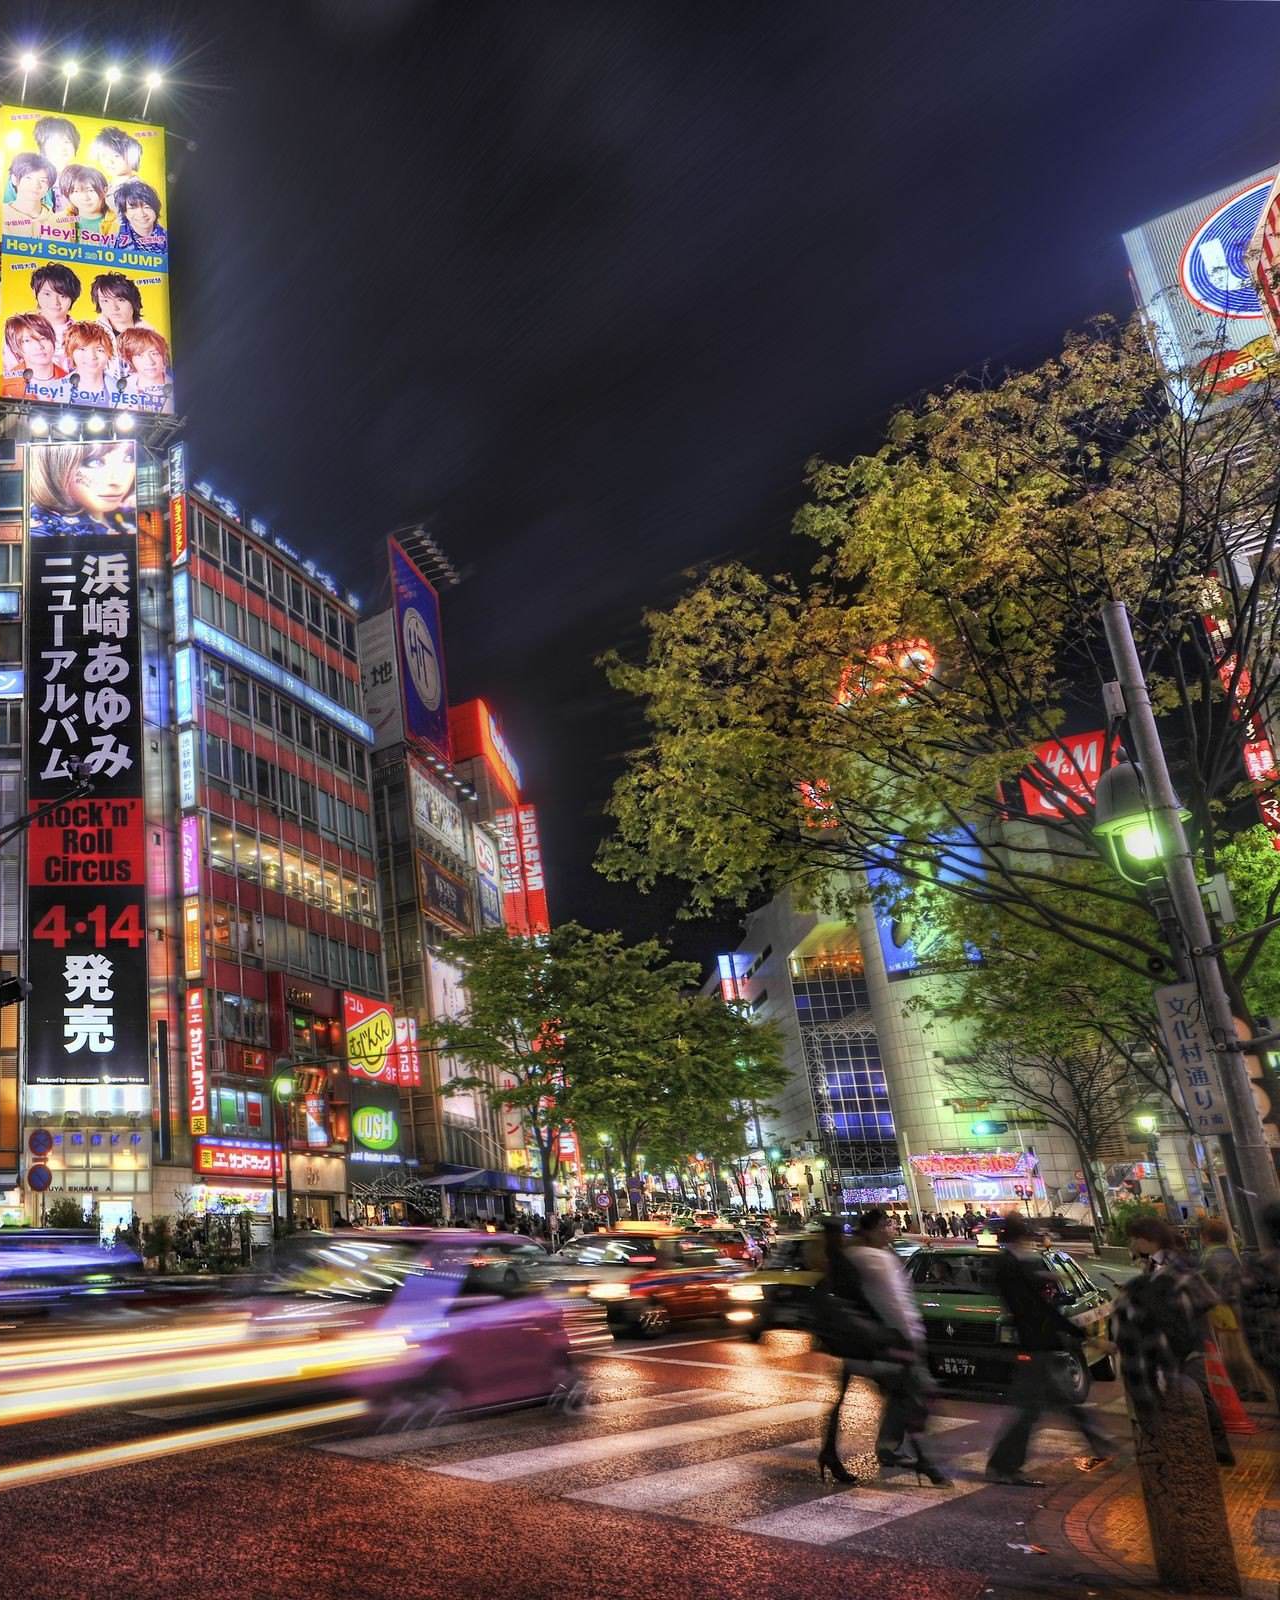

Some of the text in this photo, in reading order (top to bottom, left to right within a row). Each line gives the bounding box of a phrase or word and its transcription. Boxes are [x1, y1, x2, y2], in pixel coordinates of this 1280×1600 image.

[40, 225, 77, 241] Hey!
[81, 230, 115, 246] Say!
[6, 240, 43, 254] Hey!
[48, 244, 82, 259] Say!
[118, 254, 163, 267] JUMP
[27, 384, 146, 405] Hey! Say! BEST
[38, 553, 134, 781] 浜崎あゆみ ニューアルバム
[37, 801, 136, 828] Rock'n'
[62, 828, 113, 855] Roll
[44, 856, 132, 883] Circus
[63, 953, 115, 1056] 発売
[1166, 996, 1213, 1111] 文化村通り
[357, 1111, 393, 1141] LUSH
